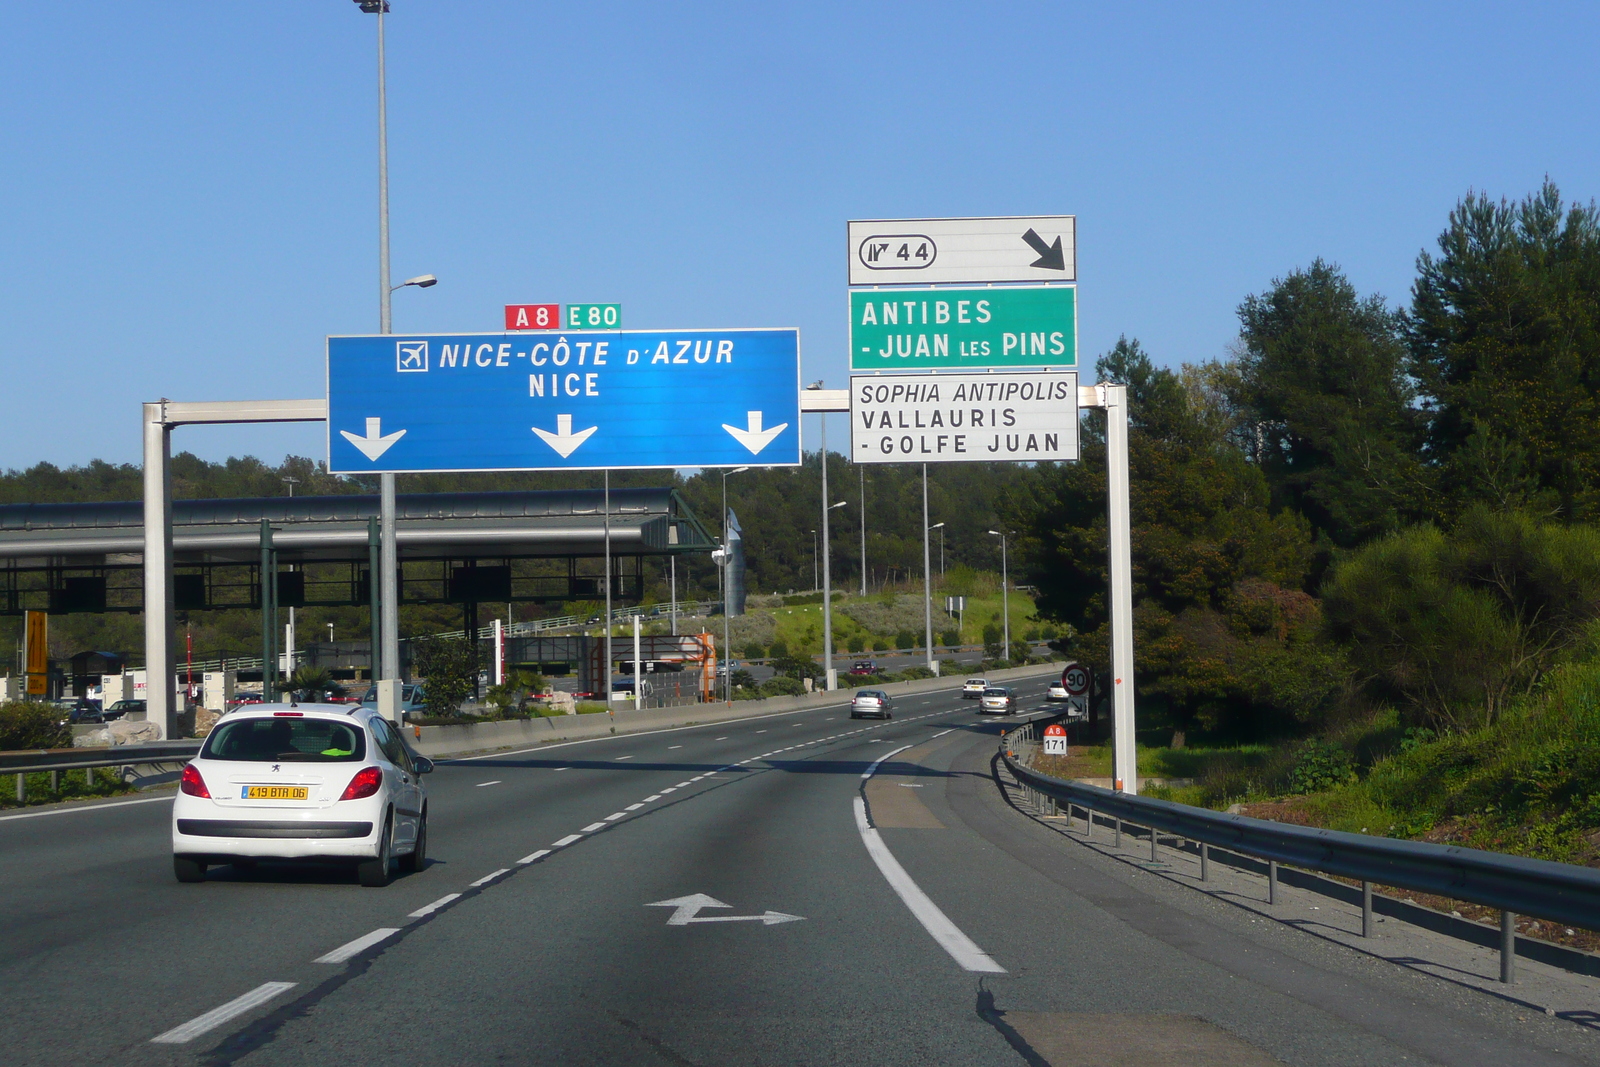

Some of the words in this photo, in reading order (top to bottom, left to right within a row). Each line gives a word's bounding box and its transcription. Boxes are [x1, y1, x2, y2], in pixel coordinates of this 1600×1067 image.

[896, 242, 929, 261] 44
[570, 307, 581, 326] E
[588, 306, 617, 326] 80
[861, 300, 992, 326] ANTIBES
[960, 341, 991, 357] LES
[1002, 331, 1066, 356] PINS
[529, 373, 599, 397] NICE
[860, 384, 940, 403] SOPHIA
[952, 381, 1068, 402] ANTIPOLIS
[861, 408, 1017, 429] VALLAURIS
[987, 433, 1059, 453] JUAN
[1067, 673, 1085, 687] 90
[1045, 740, 1064, 750] 171
[249, 787, 268, 798] 419
[292, 788, 305, 798] 06
